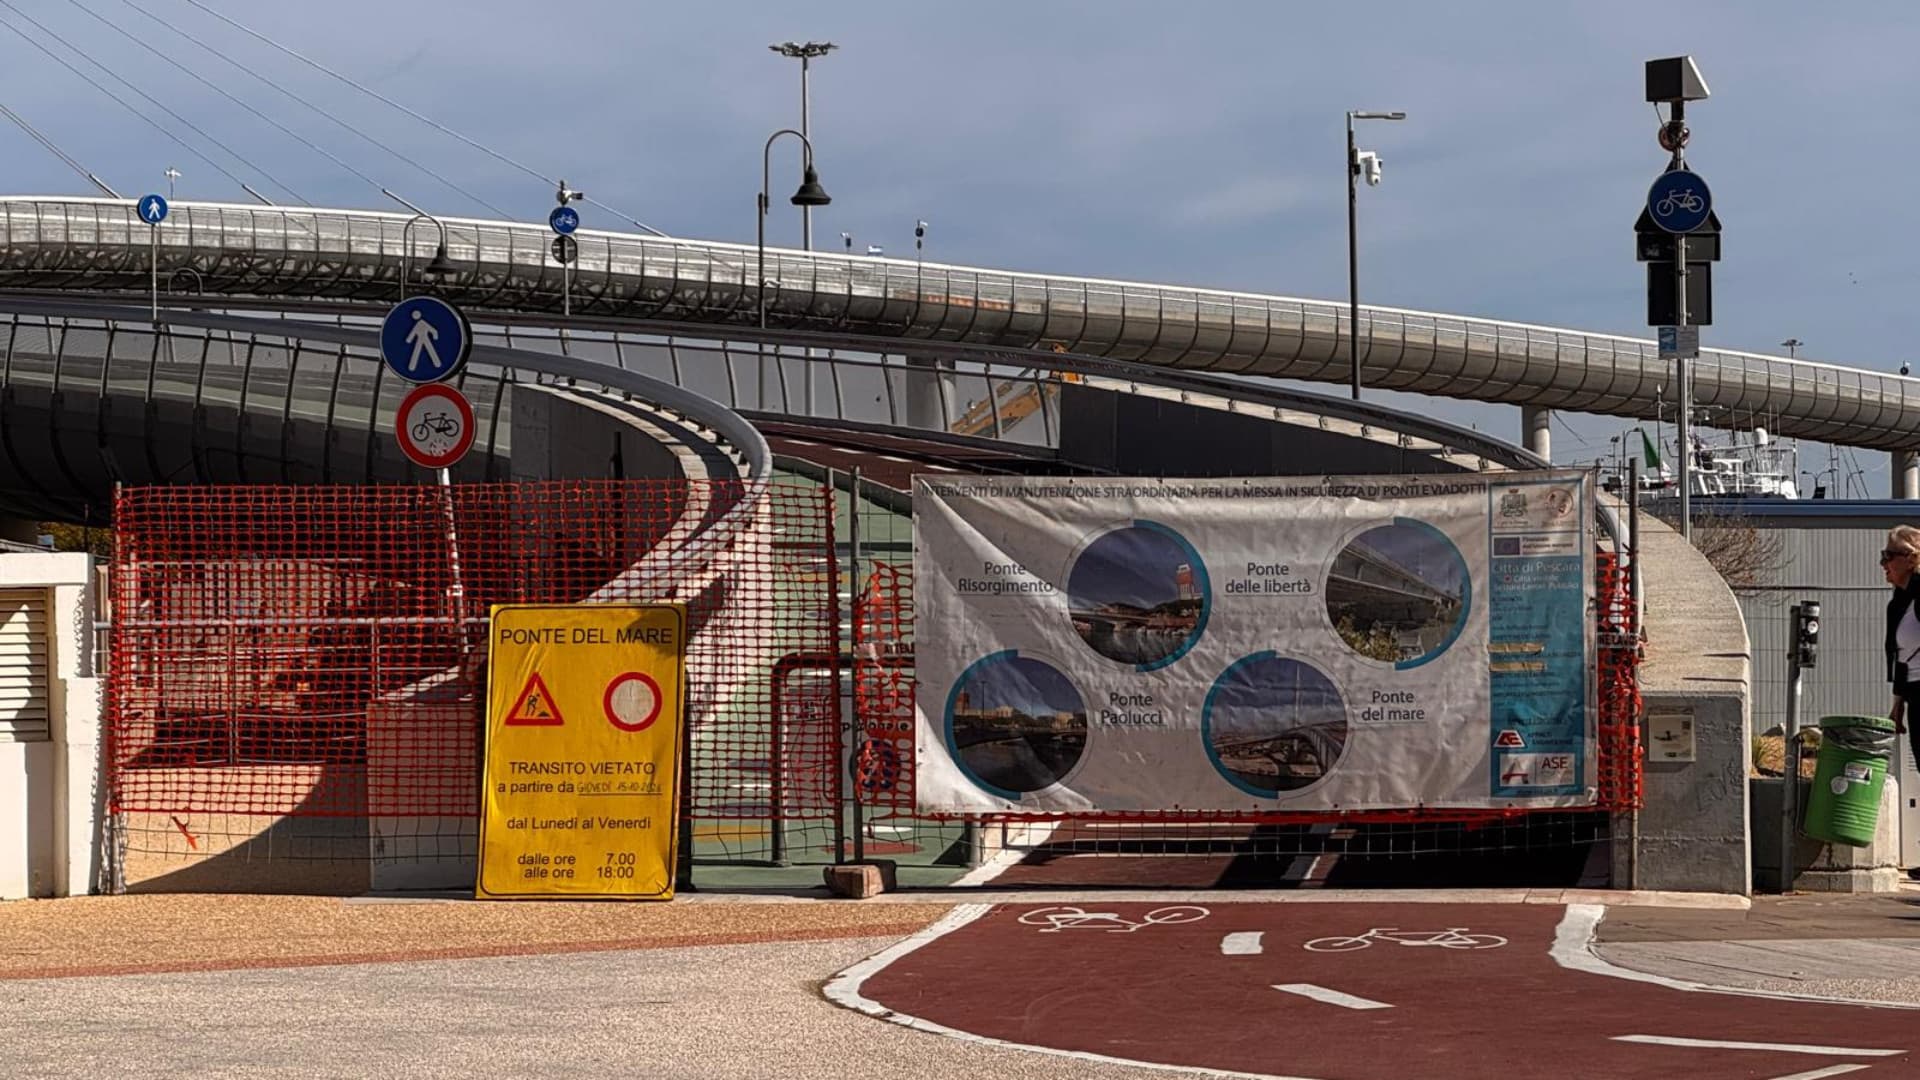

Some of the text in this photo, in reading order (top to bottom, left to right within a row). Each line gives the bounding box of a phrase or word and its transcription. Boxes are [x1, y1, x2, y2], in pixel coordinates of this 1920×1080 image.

[922, 483, 1486, 498] INTERVENTI DI MANUTENZIONE STRAORDINARIA PER LA MESSA IN SICUREZZA DI PONTI E VIADOTTI
[984, 562, 1026, 575] Ponte
[1247, 562, 1289, 576] Ponte
[958, 578, 1053, 595] Risorgimento
[1225, 579, 1311, 593] delle libertà
[500, 628, 673, 645] PONTE DEL MARE
[1109, 692, 1153, 706] Ponte
[1372, 690, 1415, 704] Ponte
[1101, 709, 1163, 725] Paolucci
[1362, 707, 1425, 721] del mare
[509, 761, 656, 775] TRANSITO VIETATO
[1541, 757, 1568, 769] ASE
[497, 781, 575, 796] a partire da
[507, 817, 527, 829] dal
[582, 817, 594, 829] al
[517, 853, 635, 865] dalle ore 7.00
[524, 867, 548, 878] alle
[552, 868, 575, 878] ore
